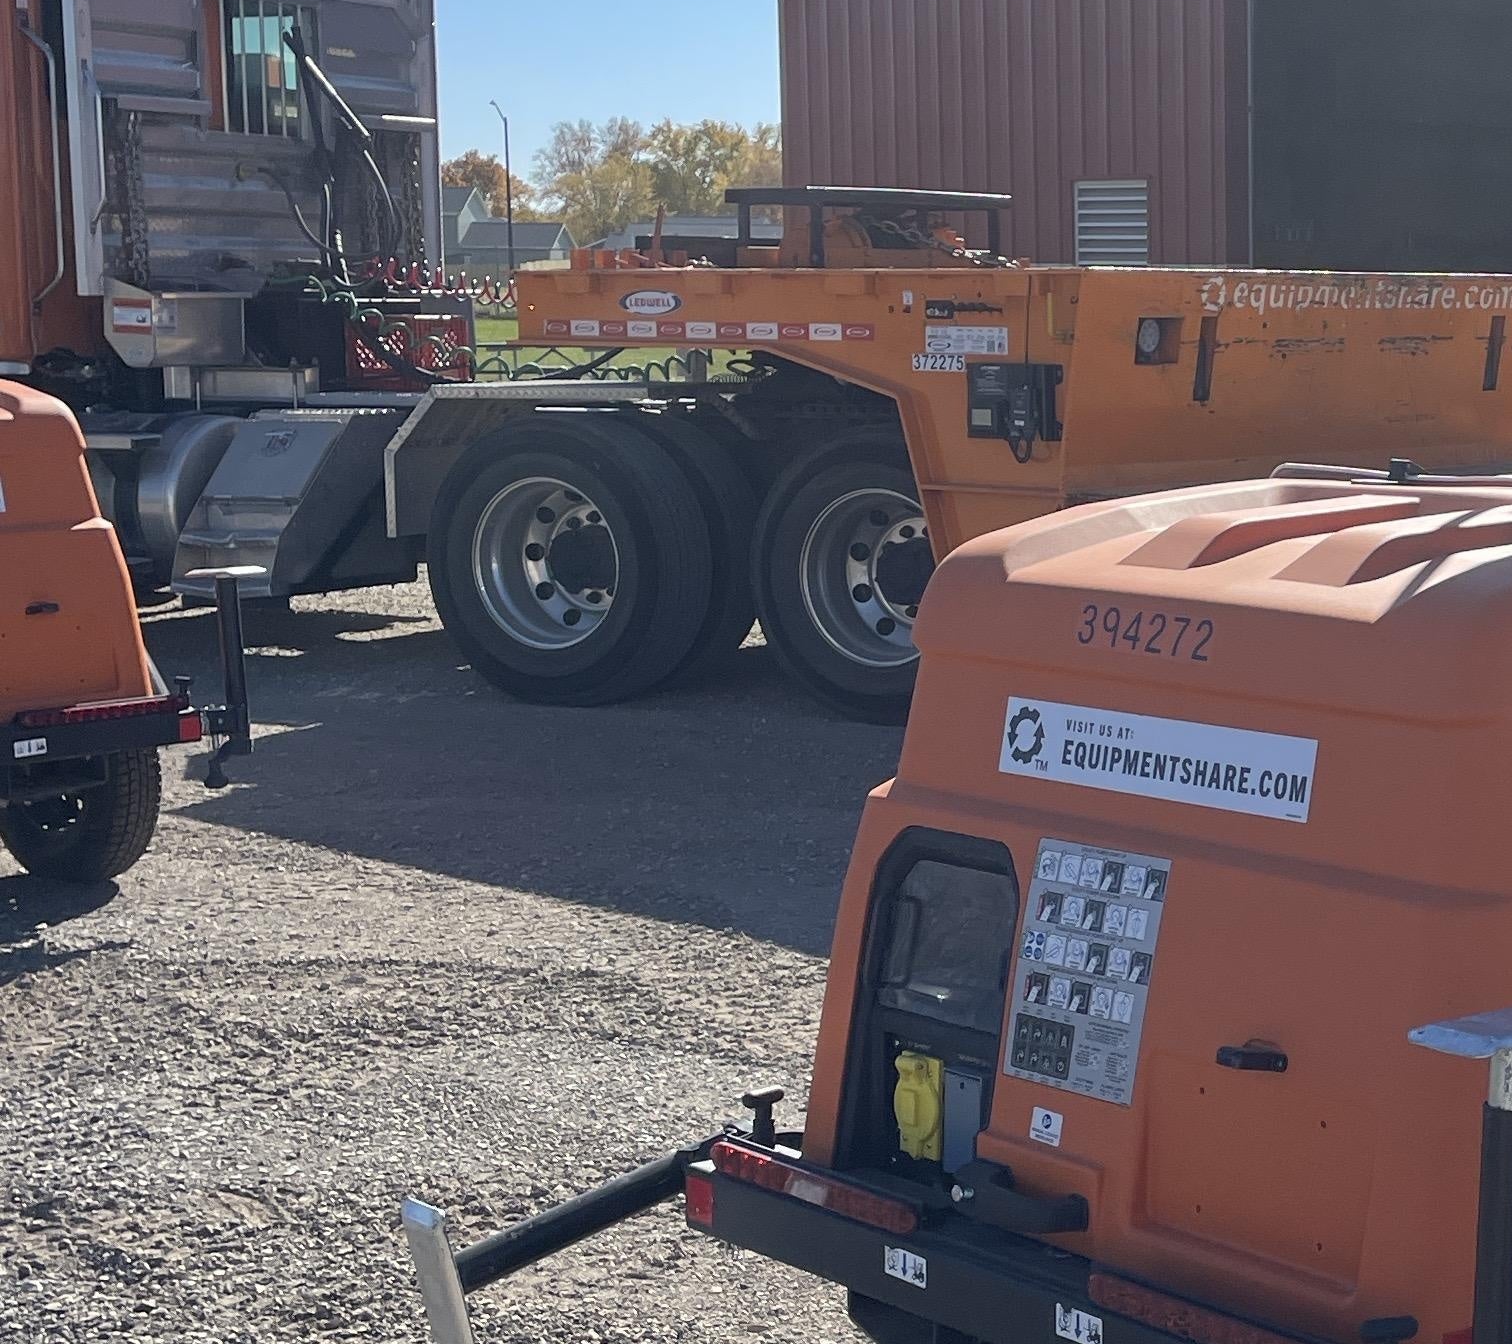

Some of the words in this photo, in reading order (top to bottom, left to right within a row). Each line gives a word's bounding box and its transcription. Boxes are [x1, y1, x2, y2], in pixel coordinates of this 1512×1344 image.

[629, 298, 671, 307] LEDWELL
[913, 354, 964, 370] 372275
[1077, 605, 1213, 661] 394272
[1066, 719, 1095, 735] VISIT
[1099, 724, 1112, 737] US
[1117, 727, 1134, 740] AT:
[1061, 739, 1308, 803] EQUIPMENTSHARE.COM
